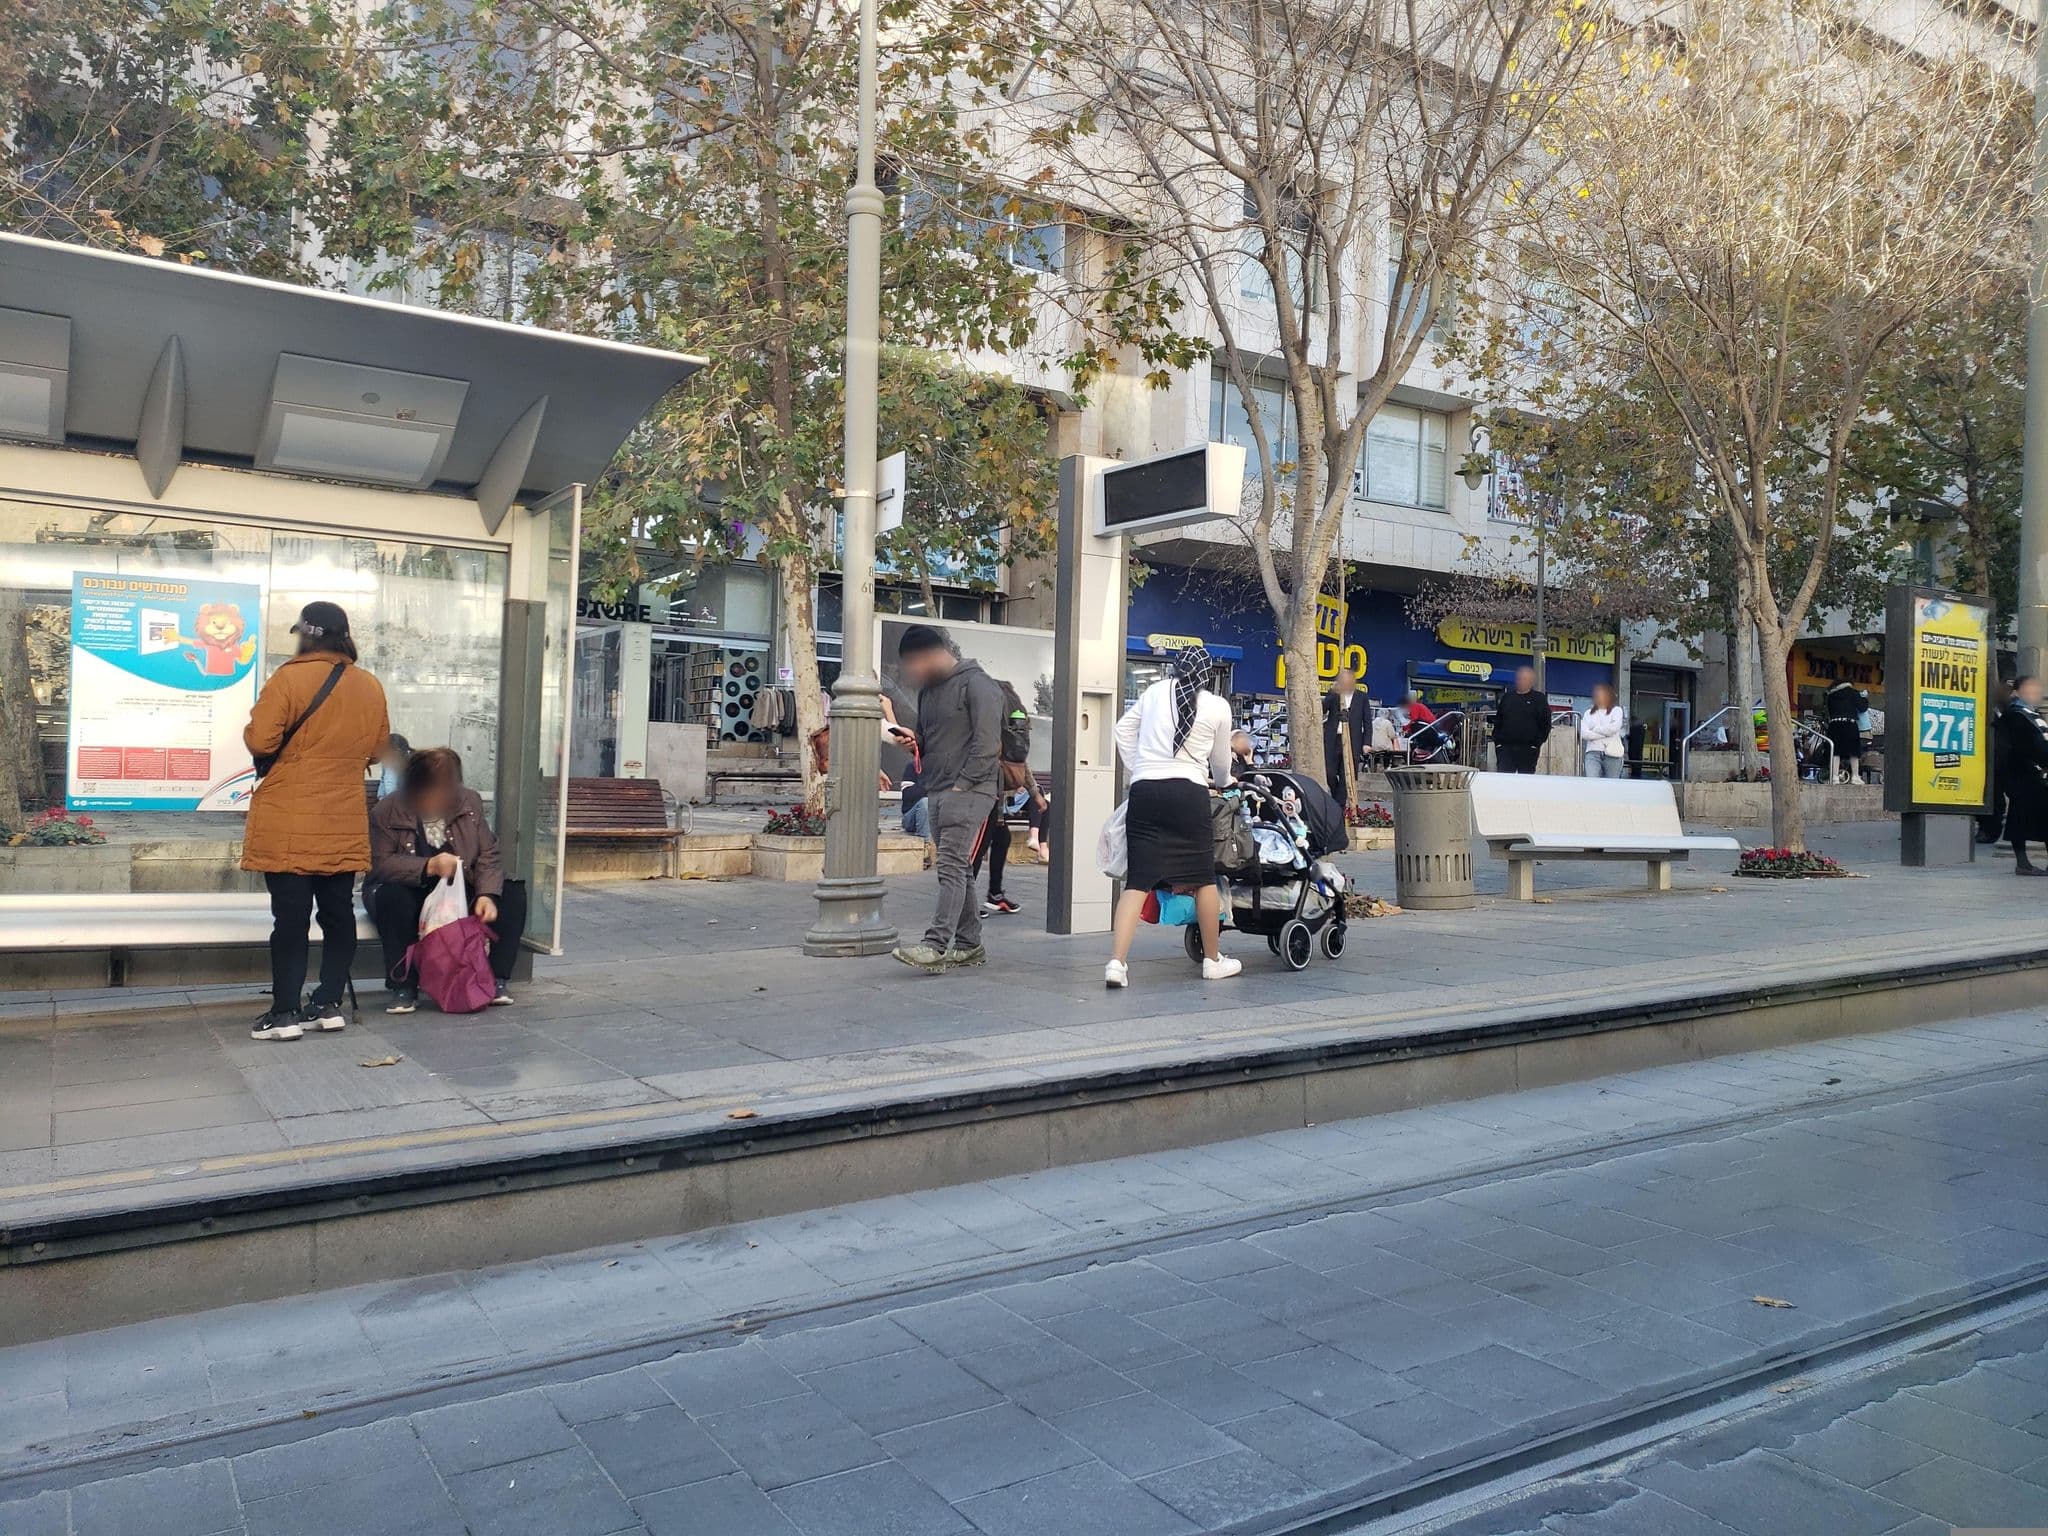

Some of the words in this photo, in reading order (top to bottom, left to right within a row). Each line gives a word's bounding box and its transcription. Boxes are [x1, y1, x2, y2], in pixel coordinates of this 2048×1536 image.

[82, 577, 127, 590] עבורכם
[130, 580, 188, 595] מתחדשים
[1459, 620, 1514, 647] בישראל
[1921, 648, 1950, 660] לעשות
[1953, 652, 1978, 665] לומדים
[1460, 663, 1480, 673] כניסה
[1920, 660, 1978, 693] IMPACT
[1922, 712, 1969, 751] 27.1
